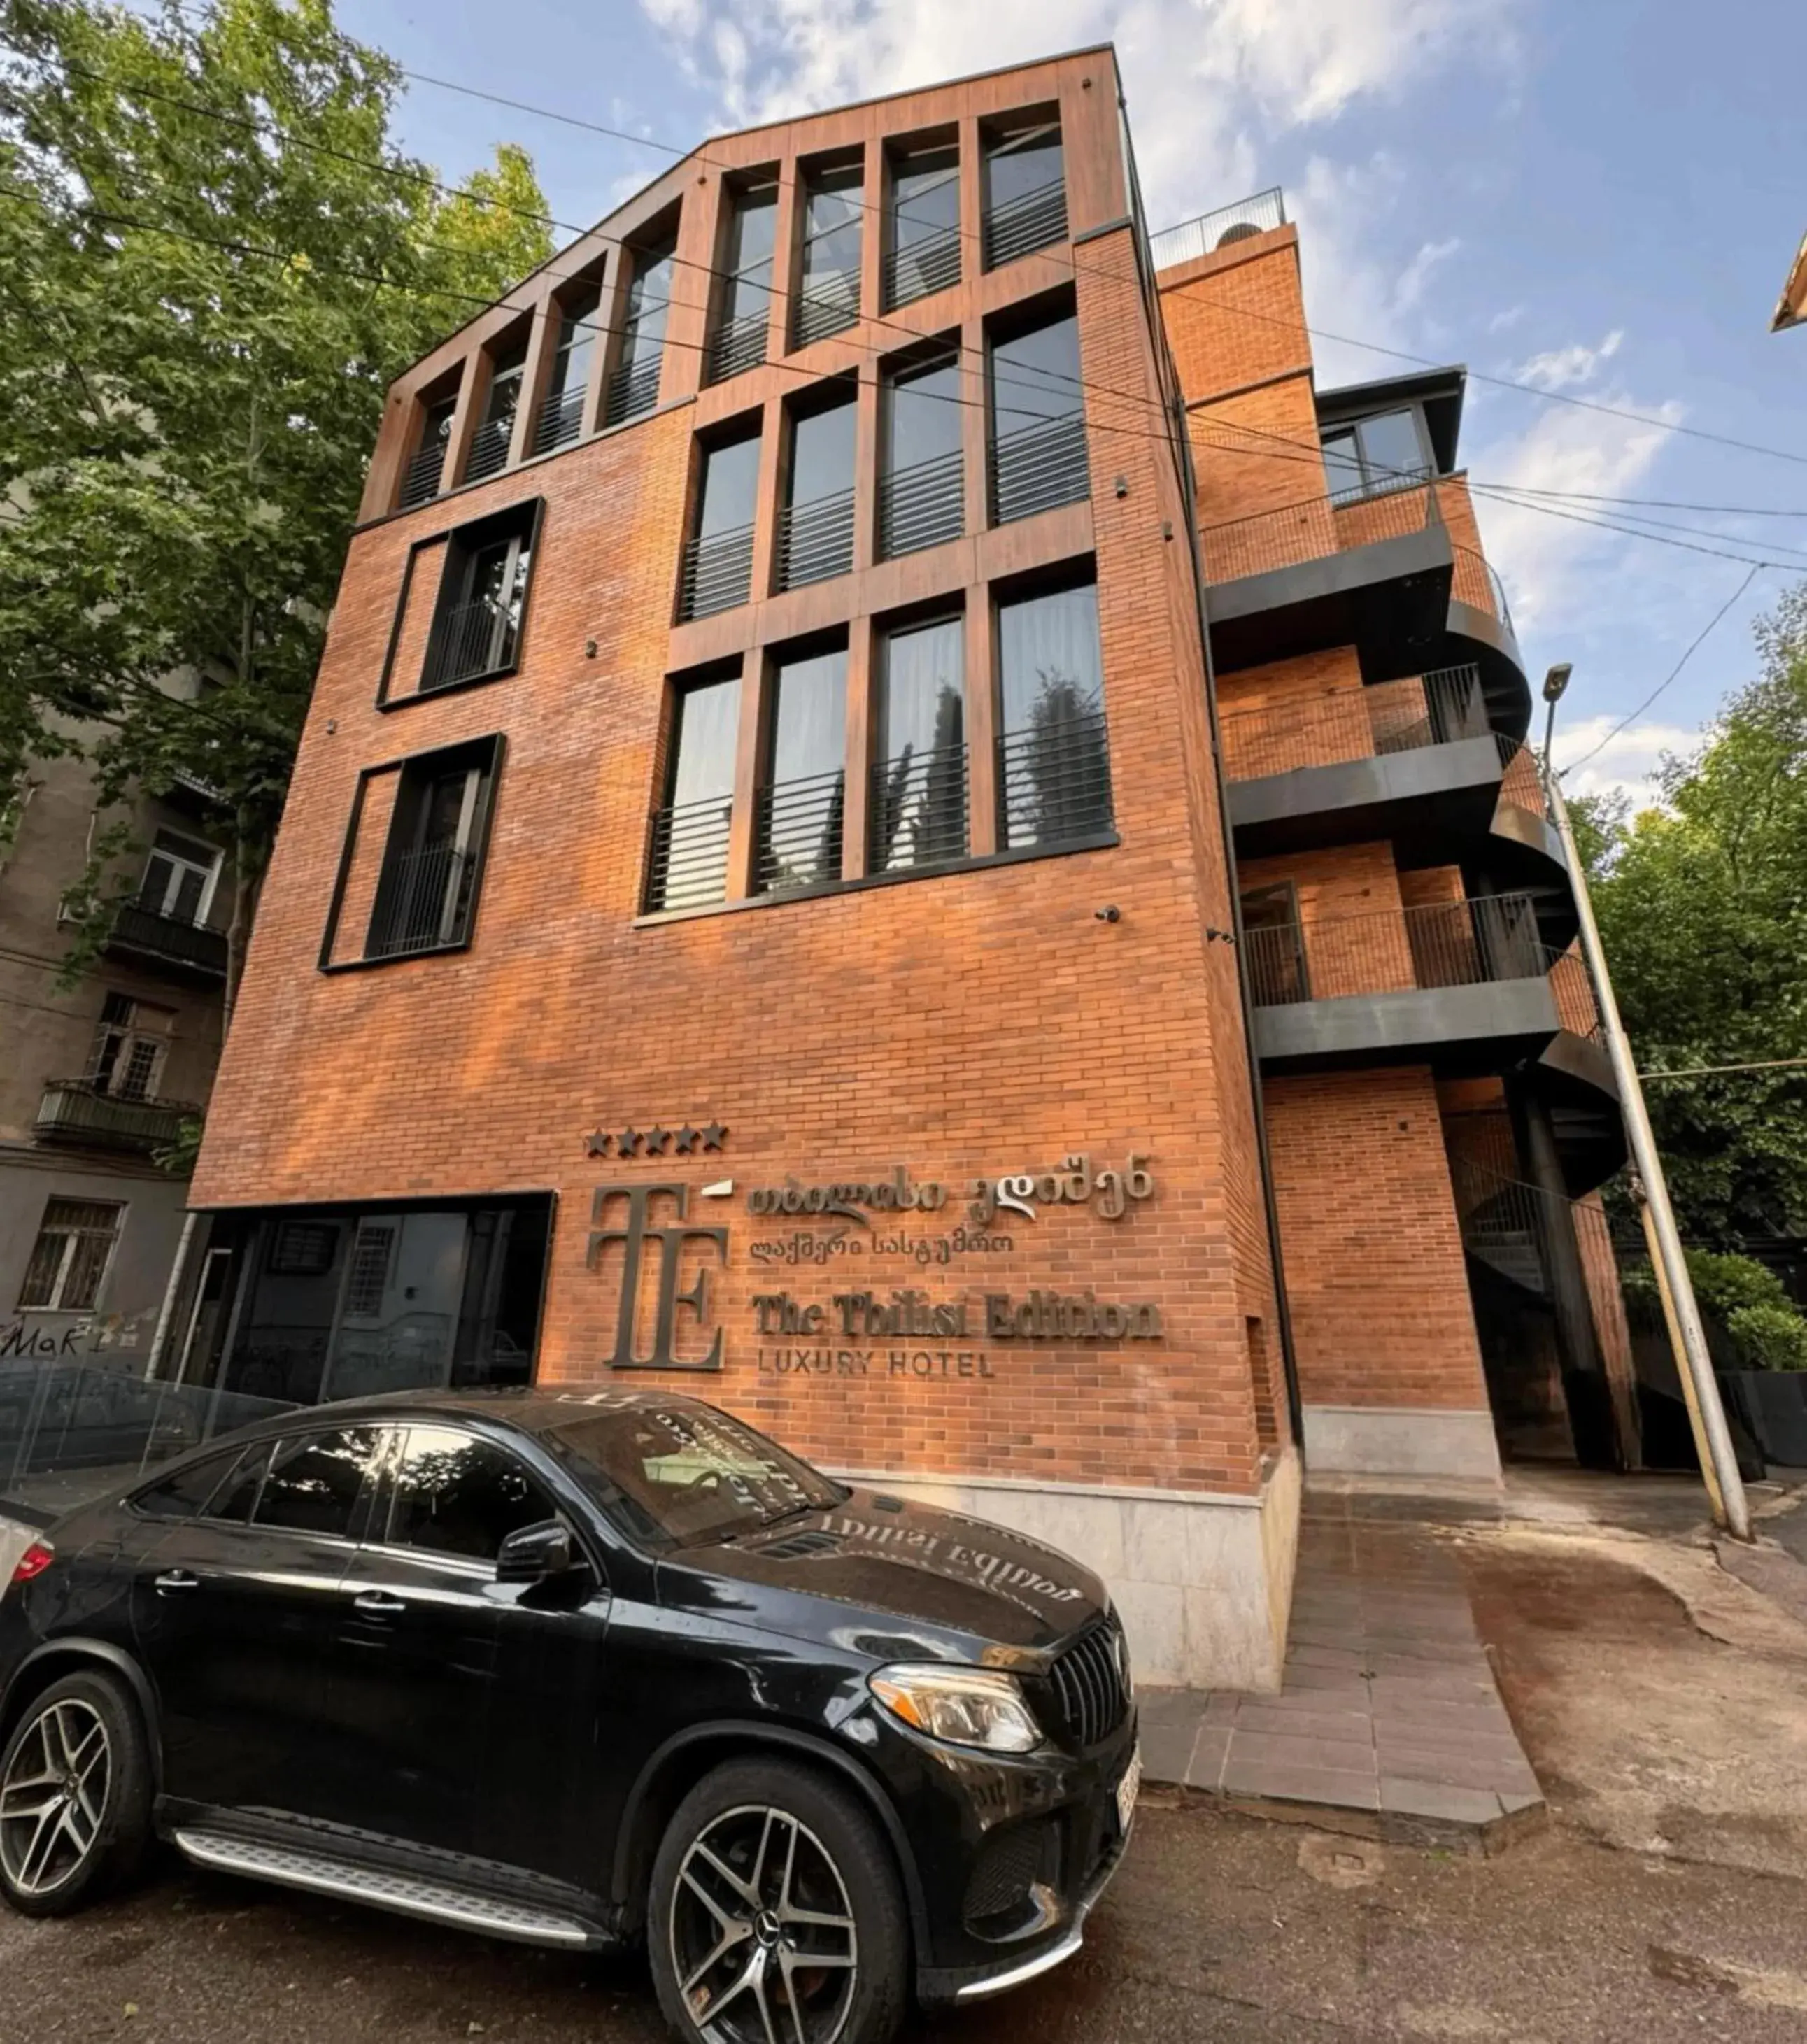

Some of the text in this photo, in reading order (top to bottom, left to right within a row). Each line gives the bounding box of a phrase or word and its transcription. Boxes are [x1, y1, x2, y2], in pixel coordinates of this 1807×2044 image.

[747, 1149, 1154, 1227] თბილისი ედიშენ
[750, 1225, 1014, 1265] ლაქშერი სასტუმრო
[751, 1289, 1164, 1337] The Tbilisi Edition
[758, 1348, 996, 1378] LUXURY HOTEL
